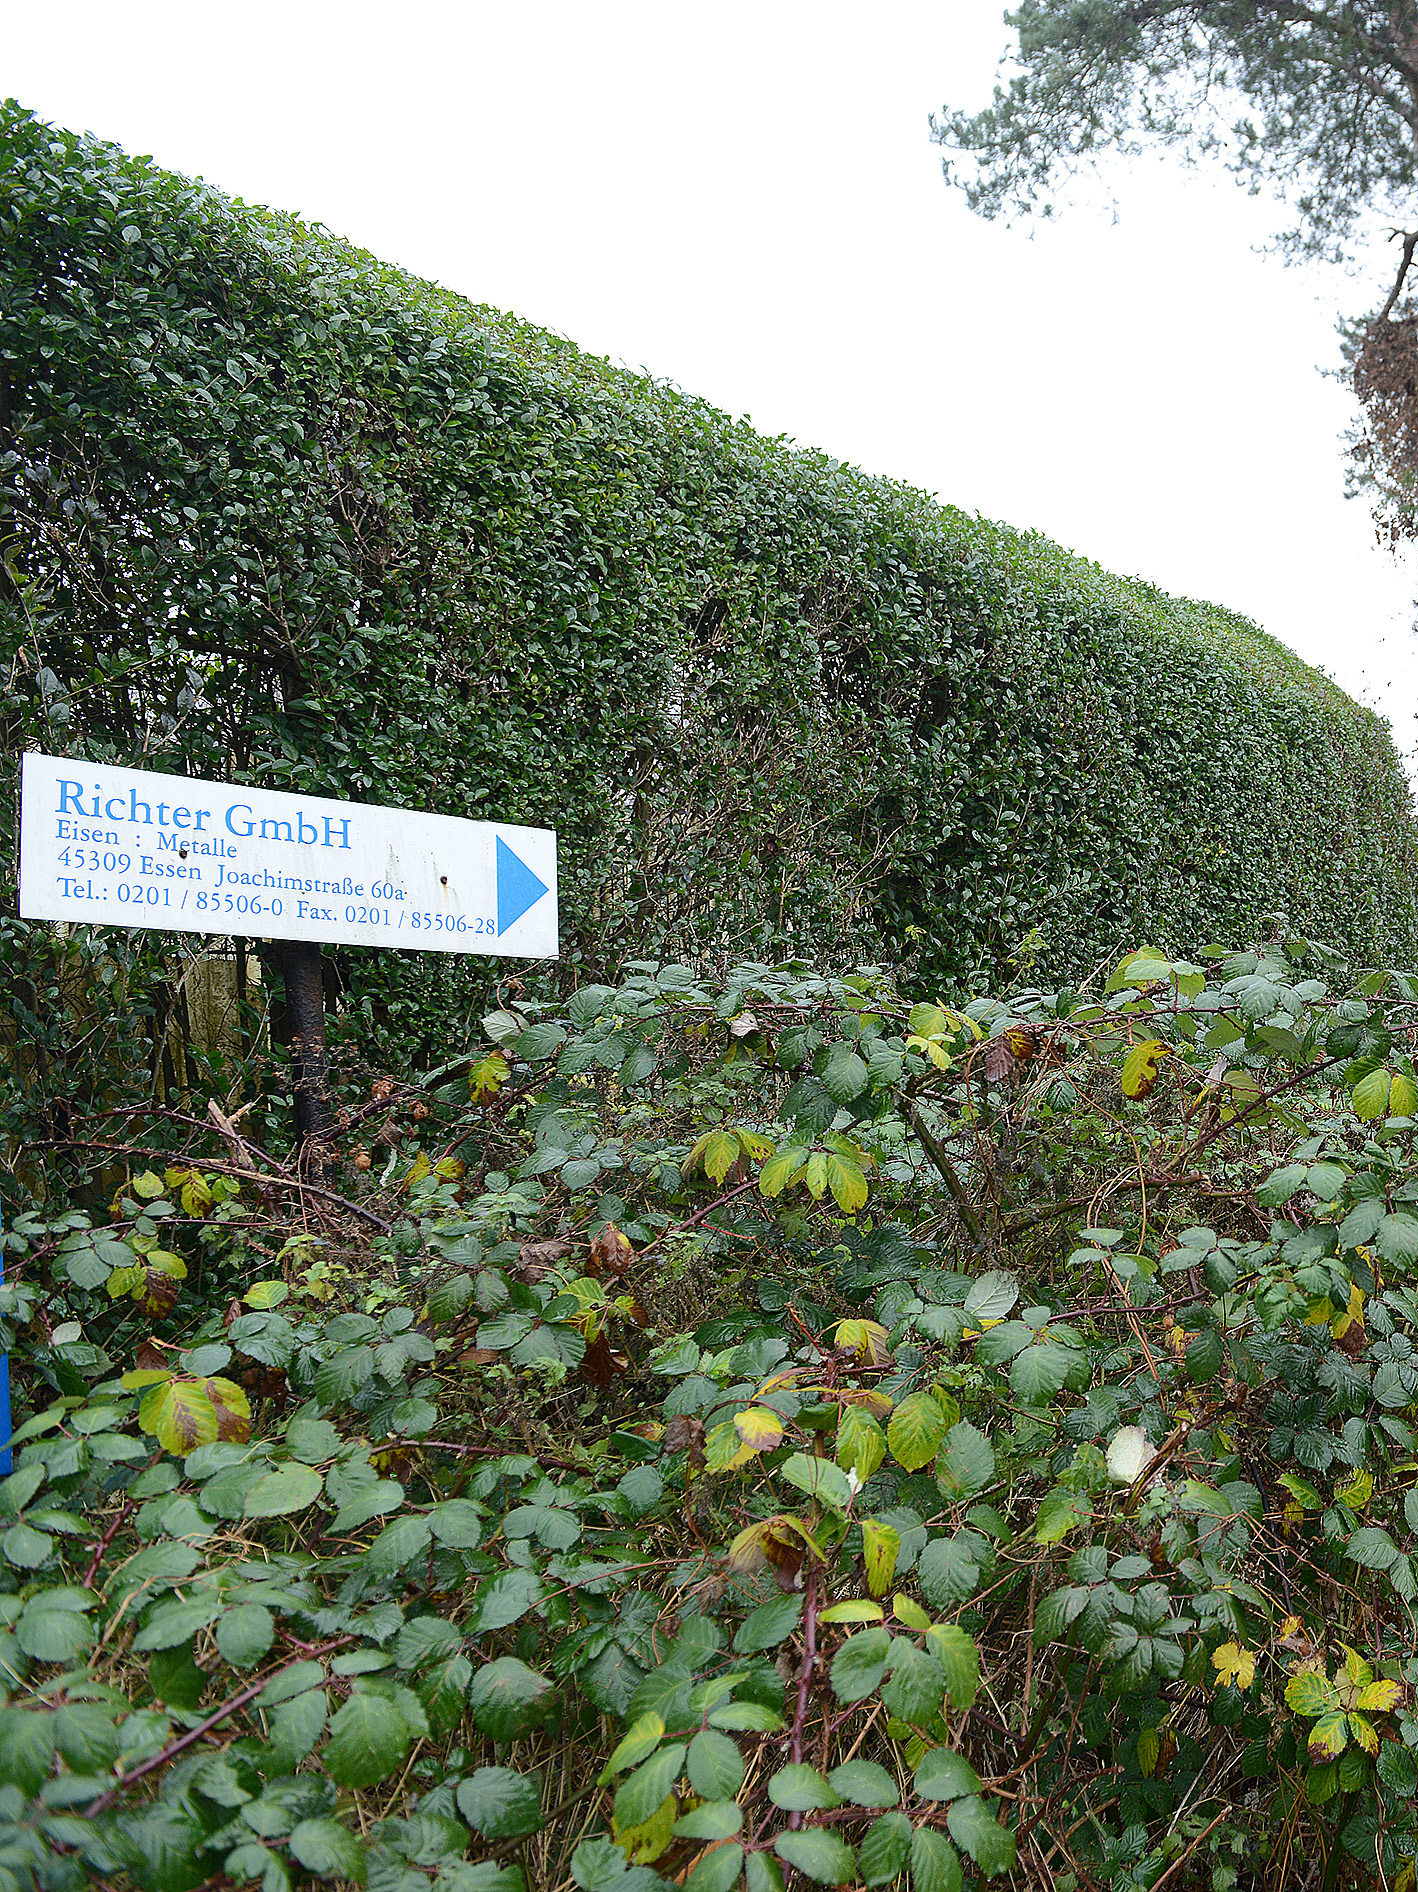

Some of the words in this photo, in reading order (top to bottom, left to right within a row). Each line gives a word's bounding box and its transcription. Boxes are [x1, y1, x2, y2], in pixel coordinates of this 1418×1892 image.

[55, 778, 211, 831] Richter
[225, 804, 352, 850] GmbH
[55, 819, 120, 845] Eisen
[157, 832, 238, 858] Metalle
[57, 846, 131, 875] 45309
[139, 855, 203, 880] Essen
[215, 864, 364, 897] Joachimstraße
[371, 880, 405, 901] 60a
[56, 877, 108, 900] Tel.:
[117, 883, 172, 907] 0201
[180, 889, 189, 910] /
[196, 891, 283, 917] 85506-0
[296, 900, 338, 922] Fax.
[345, 905, 391, 926] 0201
[398, 910, 405, 929] /
[411, 911, 496, 935] 85506-28
